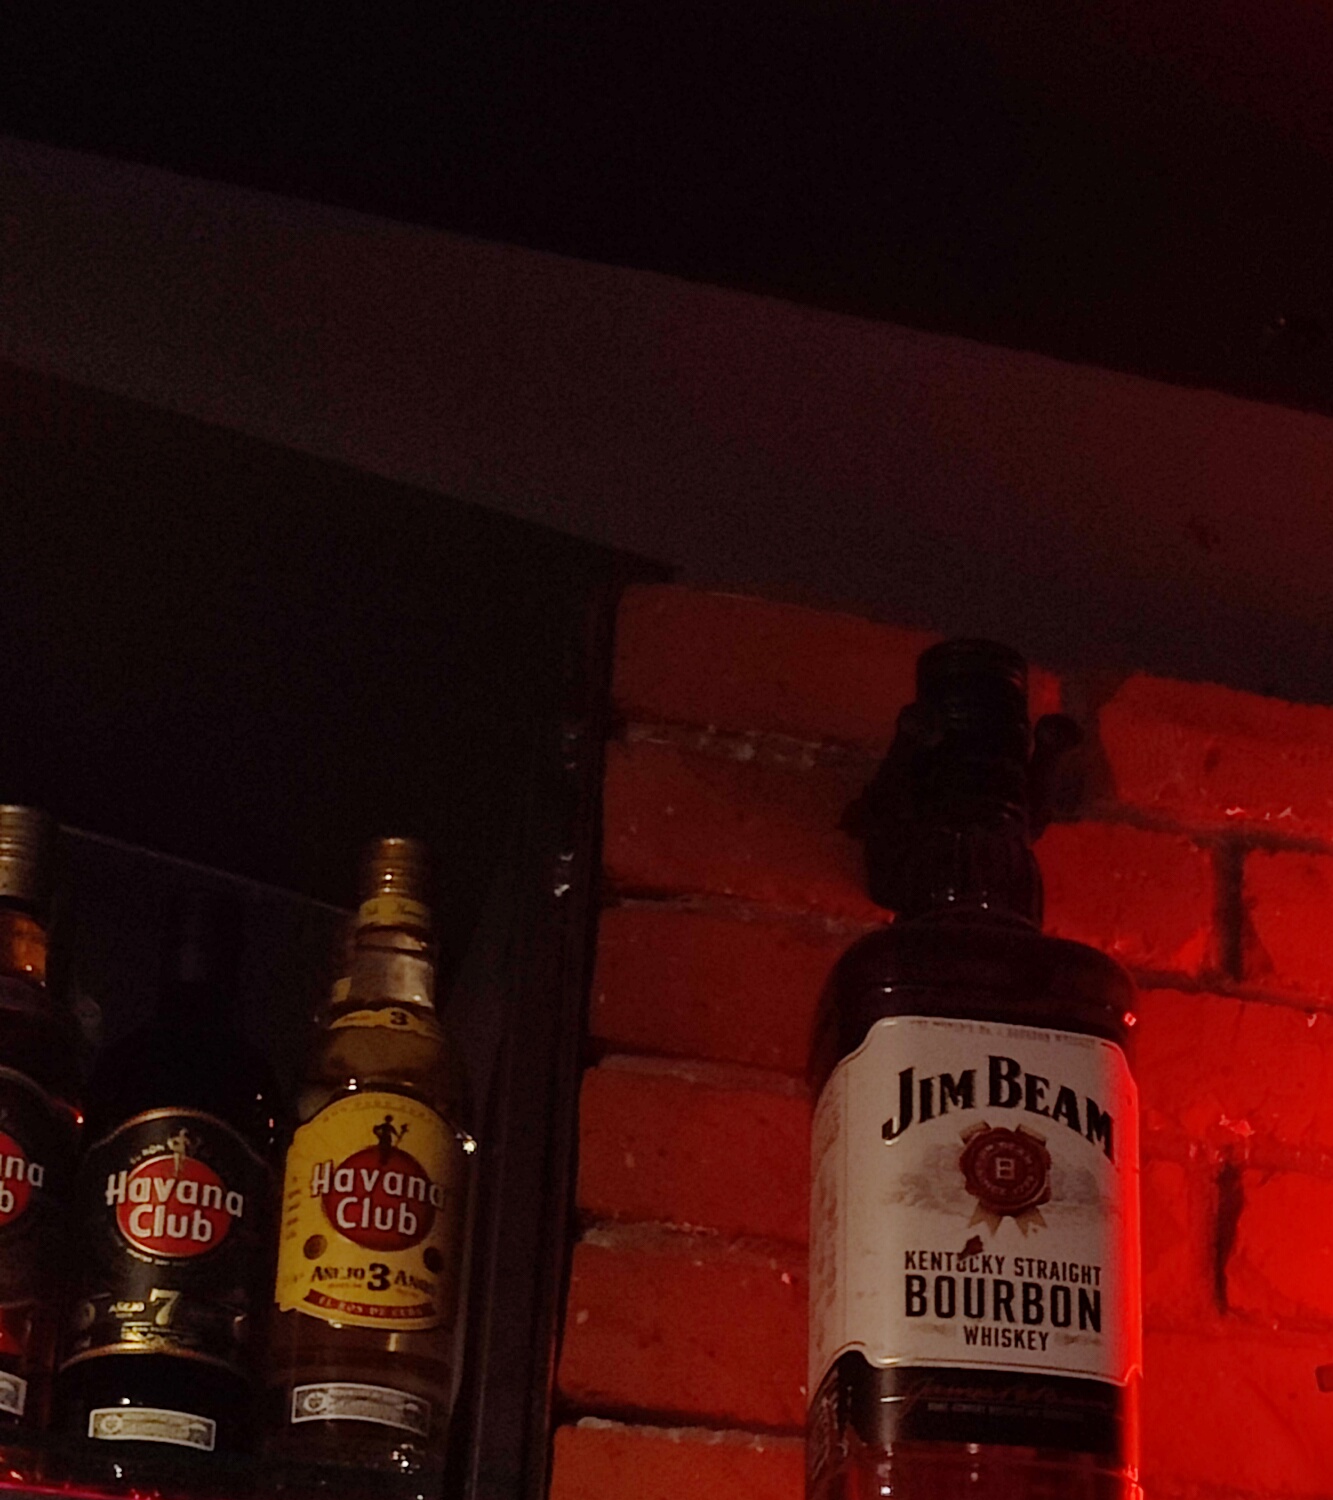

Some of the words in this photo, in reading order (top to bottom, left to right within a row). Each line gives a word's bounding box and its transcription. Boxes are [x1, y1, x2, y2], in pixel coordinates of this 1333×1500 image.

[881, 1066, 978, 1142] JIM
[988, 1055, 1117, 1166] BEAM
[105, 1170, 244, 1218] Havana
[311, 1160, 446, 1211] Havana
[128, 1203, 213, 1243] Club
[336, 1196, 418, 1236] Club
[367, 1263, 391, 1291] 3
[904, 1250, 1006, 1276] KENTUCKY
[1013, 1257, 1101, 1287] STRAIGHT
[149, 1288, 180, 1325] 7
[904, 1273, 1102, 1334] BOURBON
[963, 1324, 1050, 1352] WHISKEY
